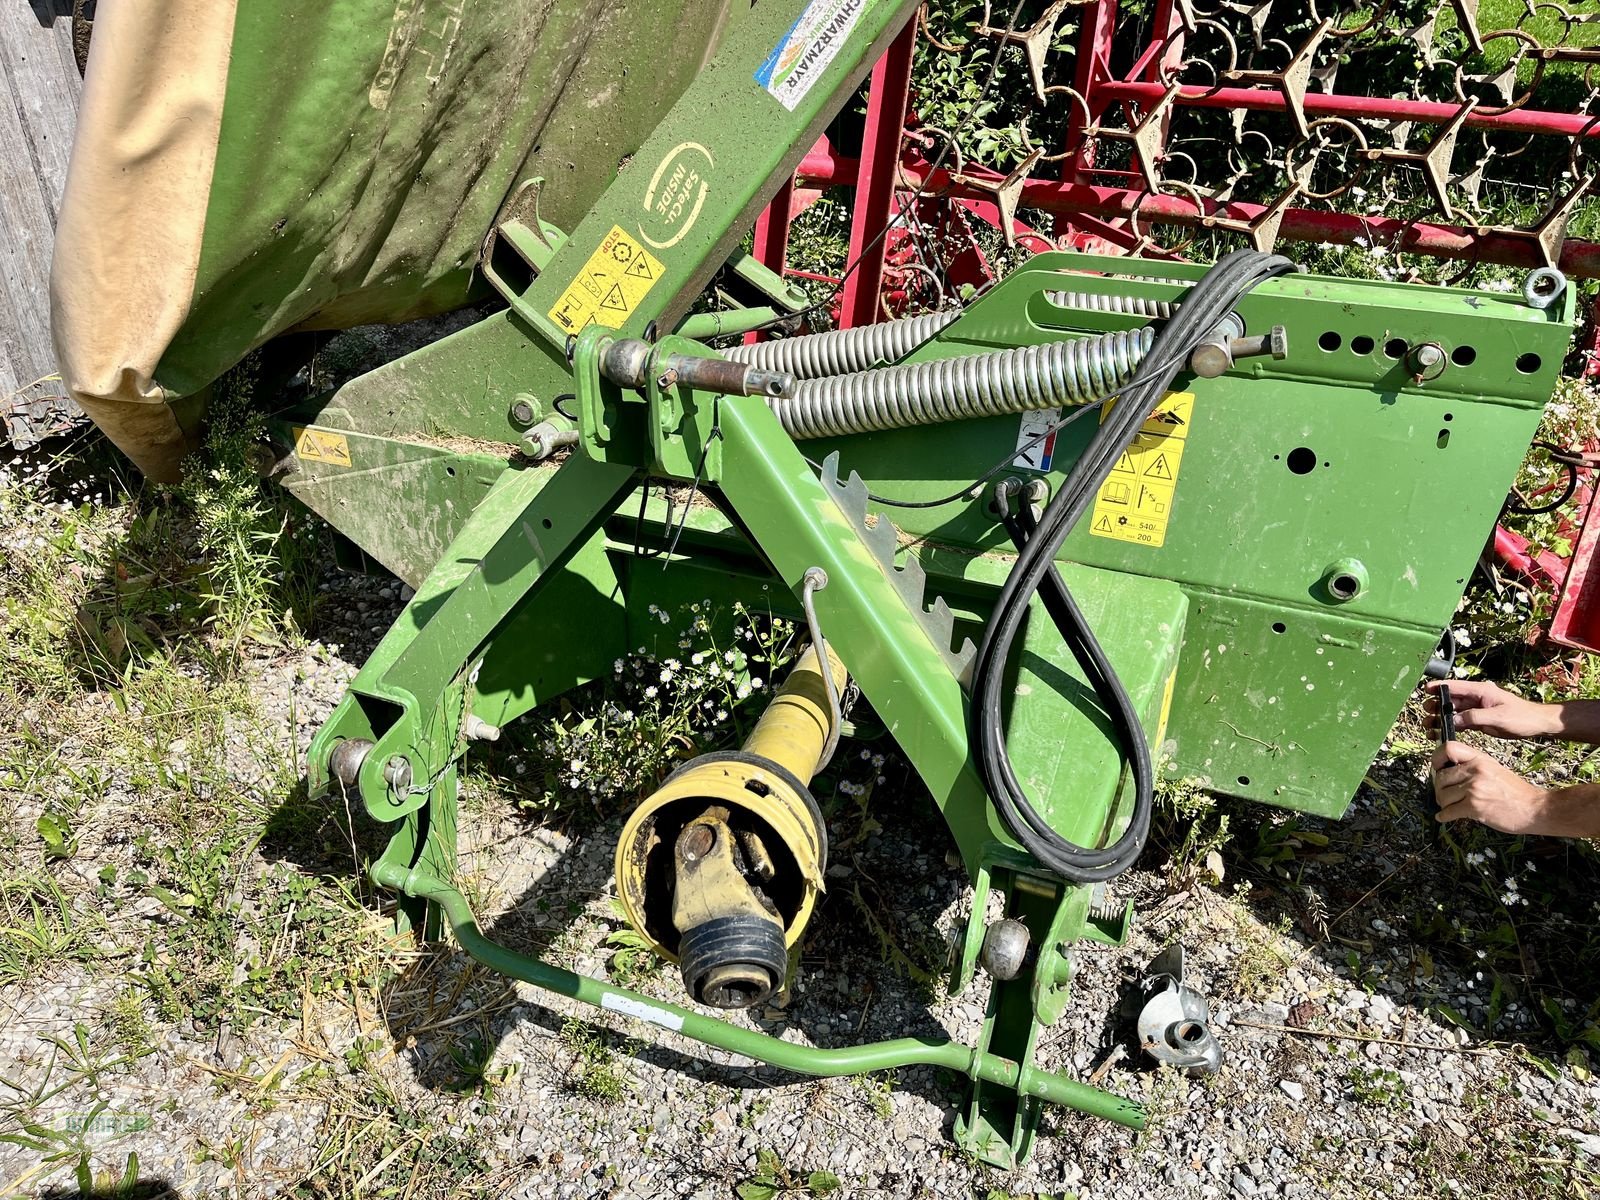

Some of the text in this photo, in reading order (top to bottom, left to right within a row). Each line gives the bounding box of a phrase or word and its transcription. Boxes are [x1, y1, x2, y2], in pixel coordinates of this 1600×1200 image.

[786, 0, 862, 89] CHWARZMAYR
[656, 163, 687, 215] INSIDE
[664, 169, 699, 224] SafeCu
[602, 231, 621, 253] STOP
[1137, 533, 1152, 542] 200
